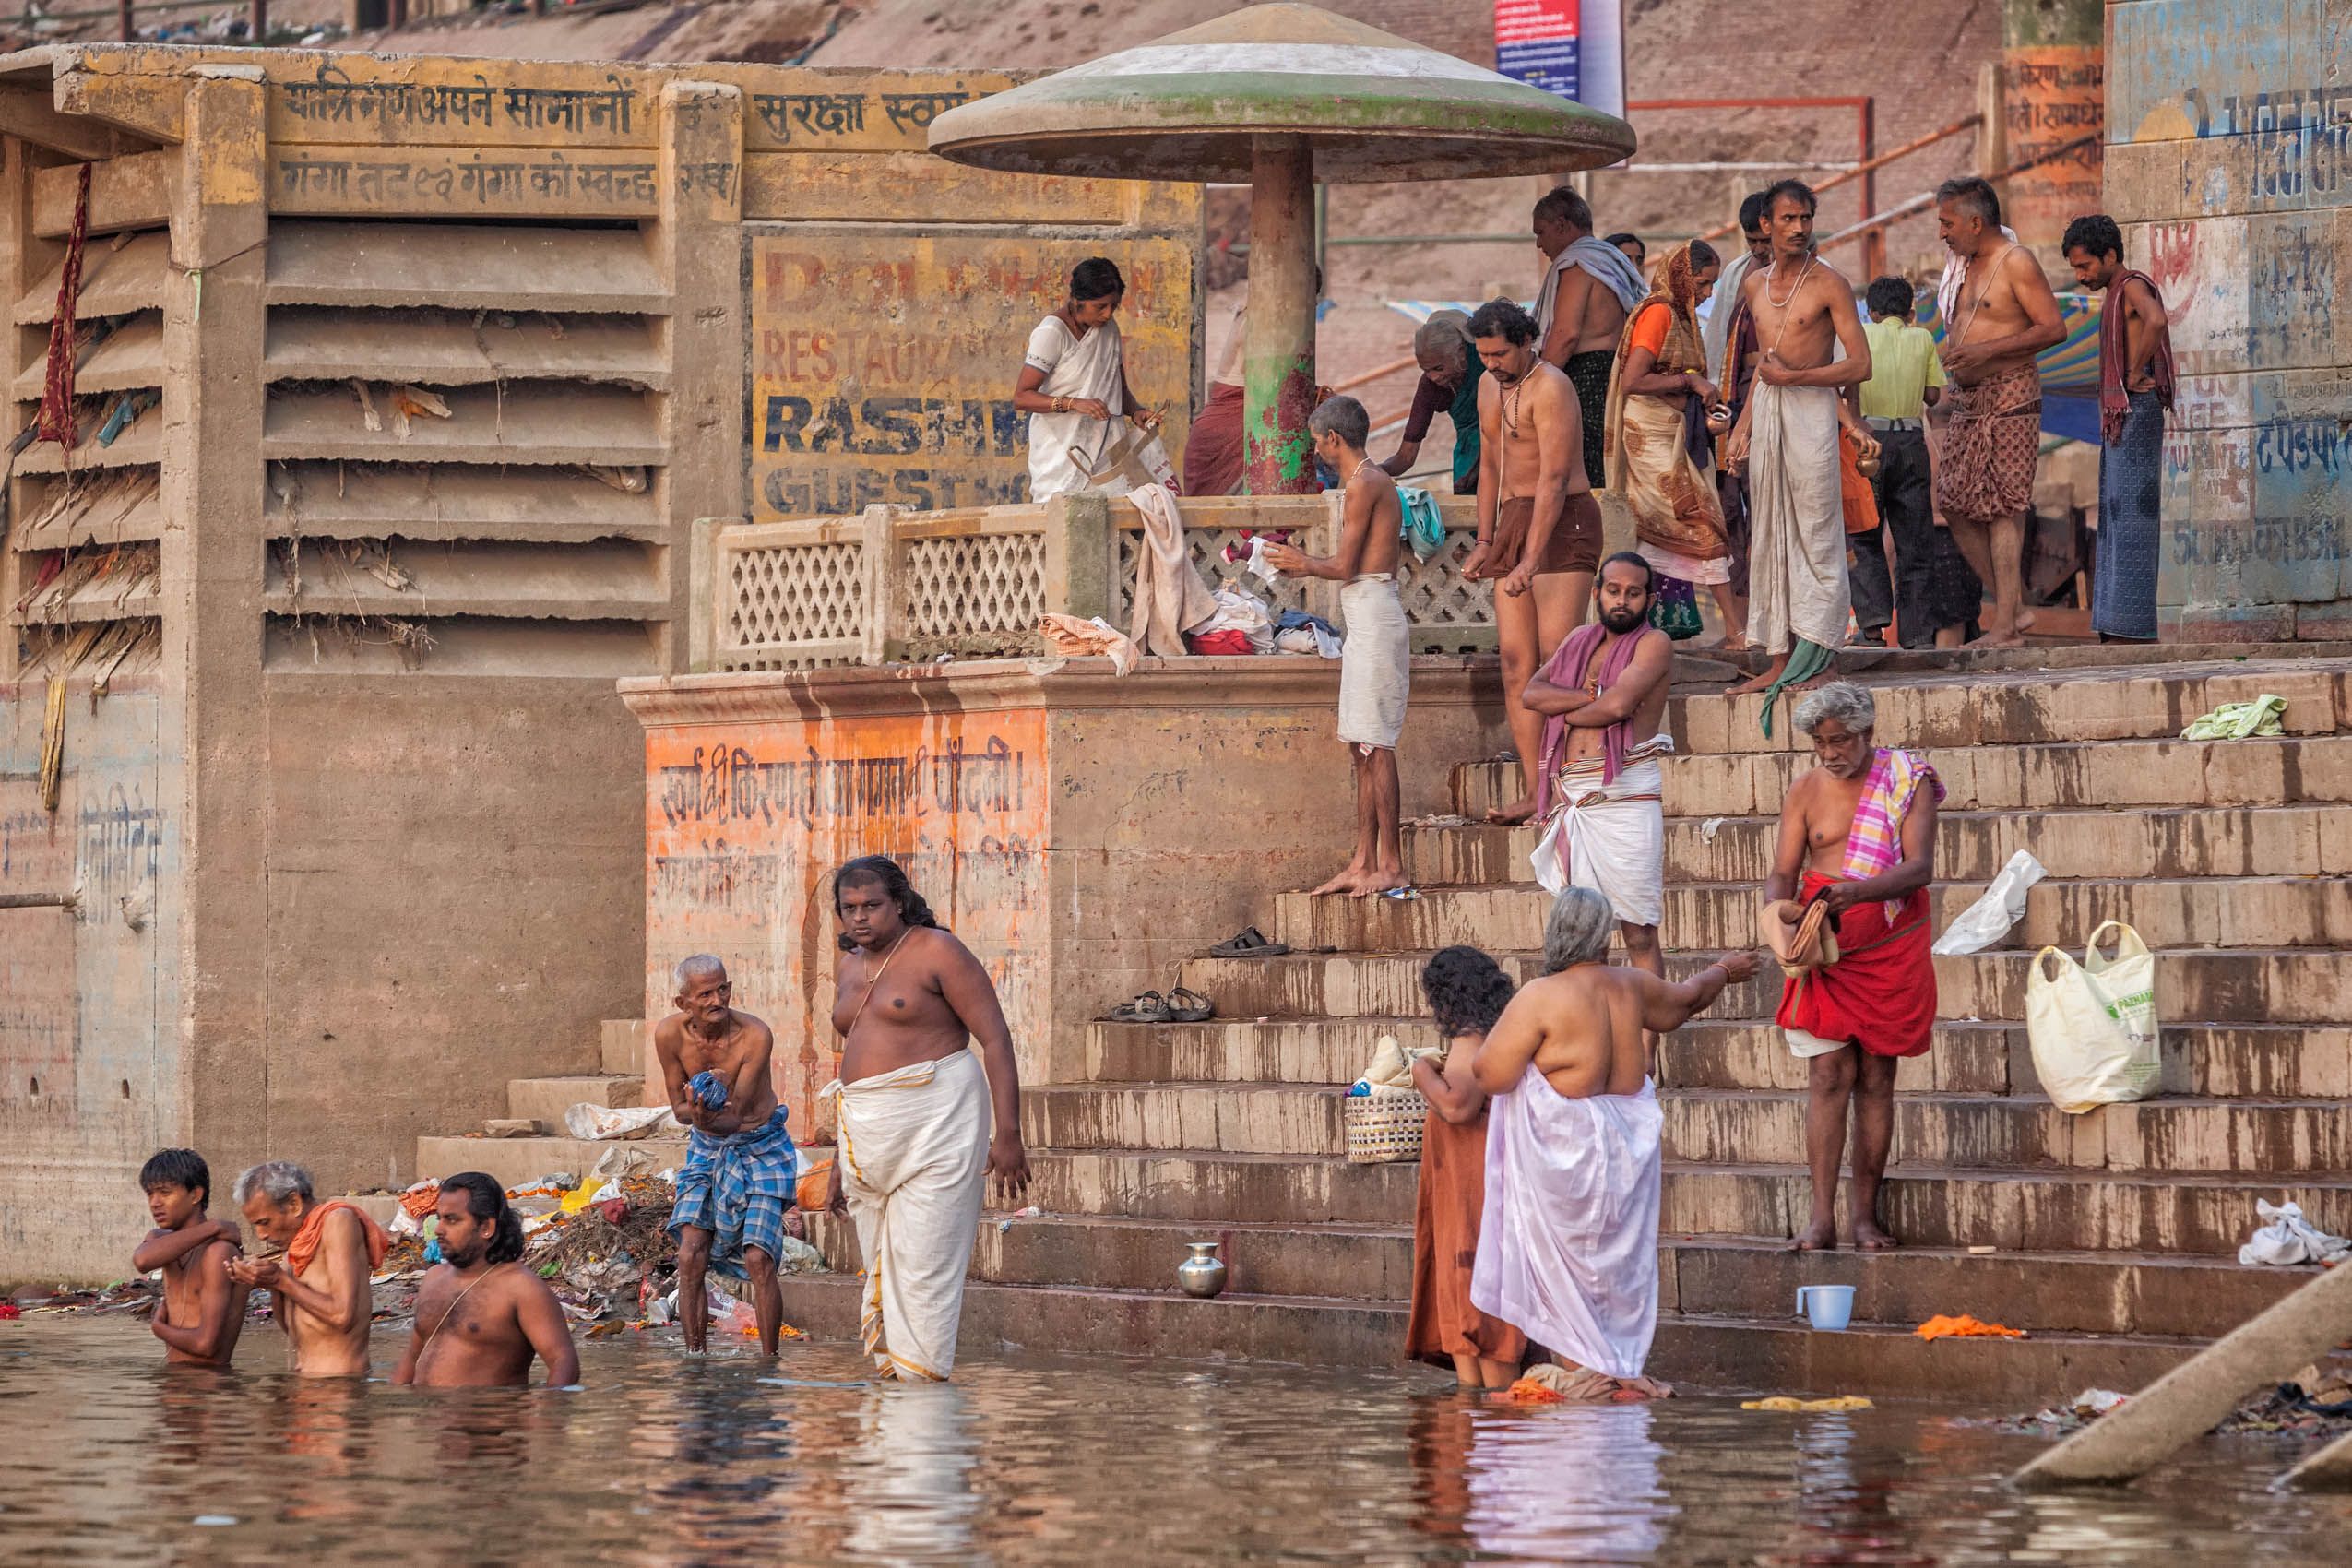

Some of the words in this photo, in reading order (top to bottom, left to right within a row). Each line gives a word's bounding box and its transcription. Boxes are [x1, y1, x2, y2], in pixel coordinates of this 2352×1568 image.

[418, 74, 496, 126] अपने
[754, 93, 865, 144] सुरक्षा
[280, 152, 353, 200] गंगा
[357, 163, 410, 202] तट
[458, 153, 525, 203] गंगा
[530, 151, 573, 200] को
[763, 396, 1032, 457] RASHM
[765, 468, 967, 515] GUEST
